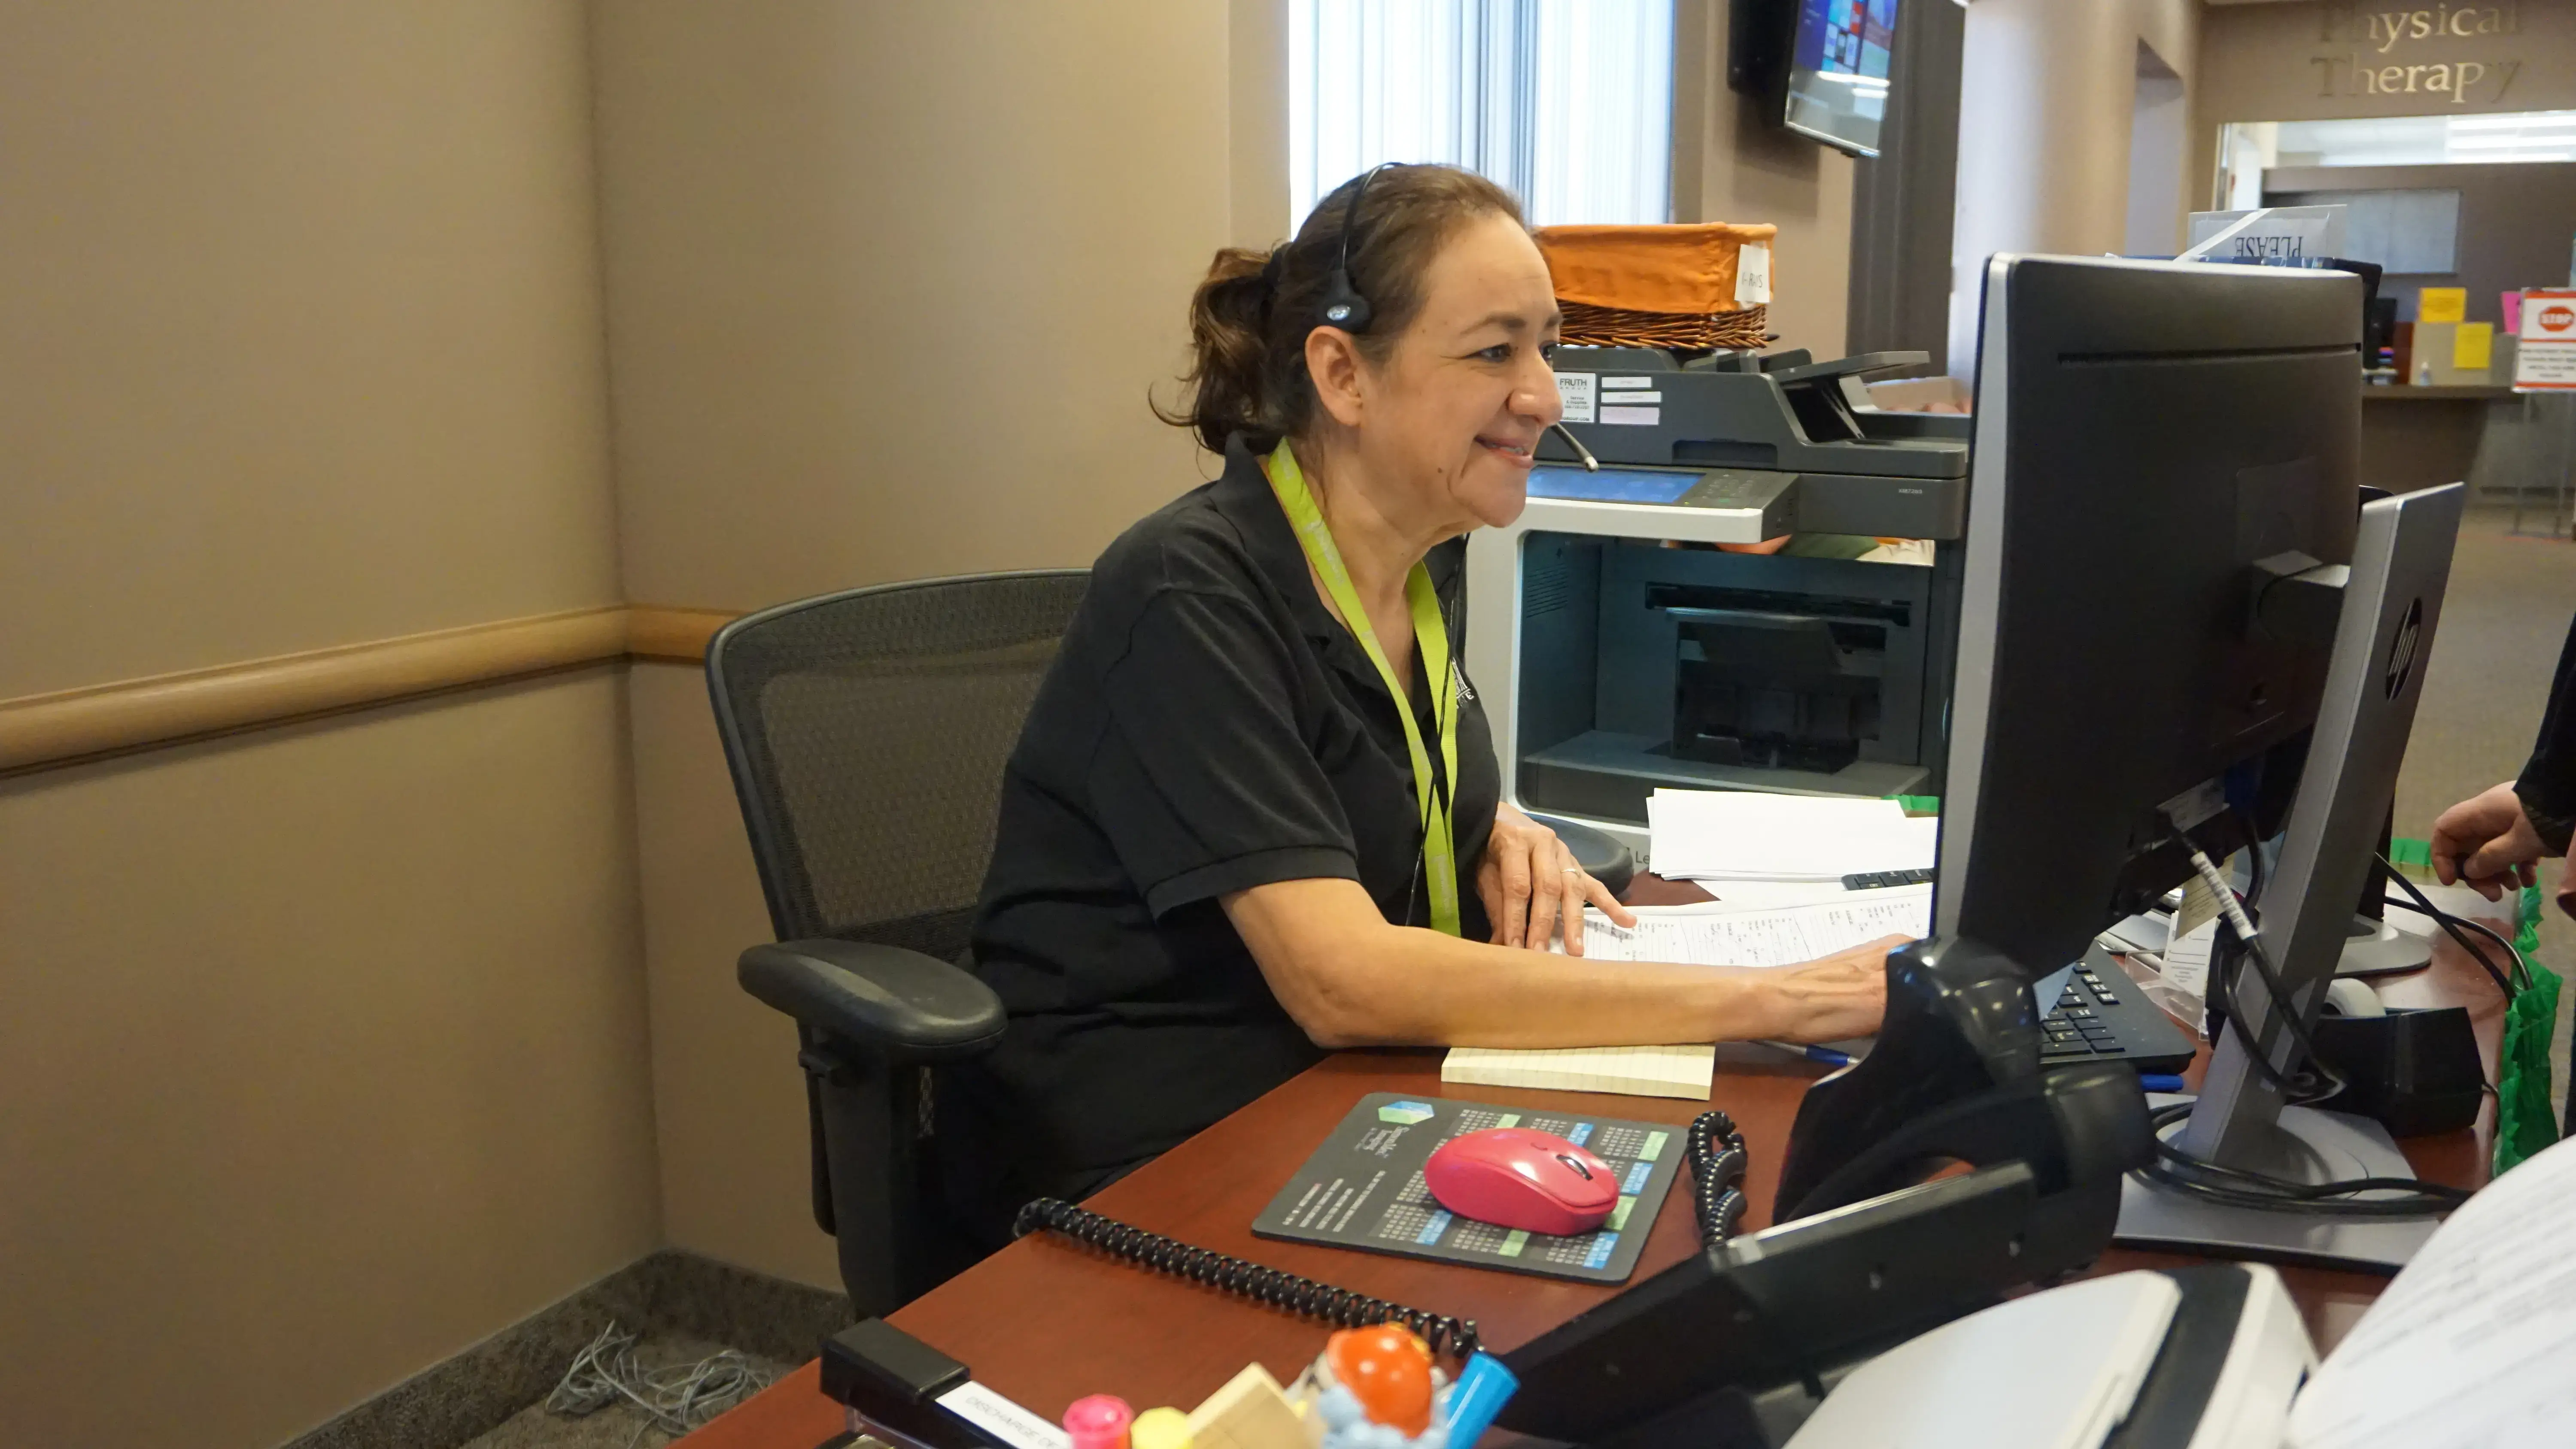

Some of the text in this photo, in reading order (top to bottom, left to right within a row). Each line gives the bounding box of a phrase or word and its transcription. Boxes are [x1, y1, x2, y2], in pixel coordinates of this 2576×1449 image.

[2310, 52, 2522, 103] Therapy
[2235, 236, 2303, 257] PLEASE
[1635, 850, 1650, 864] Le
